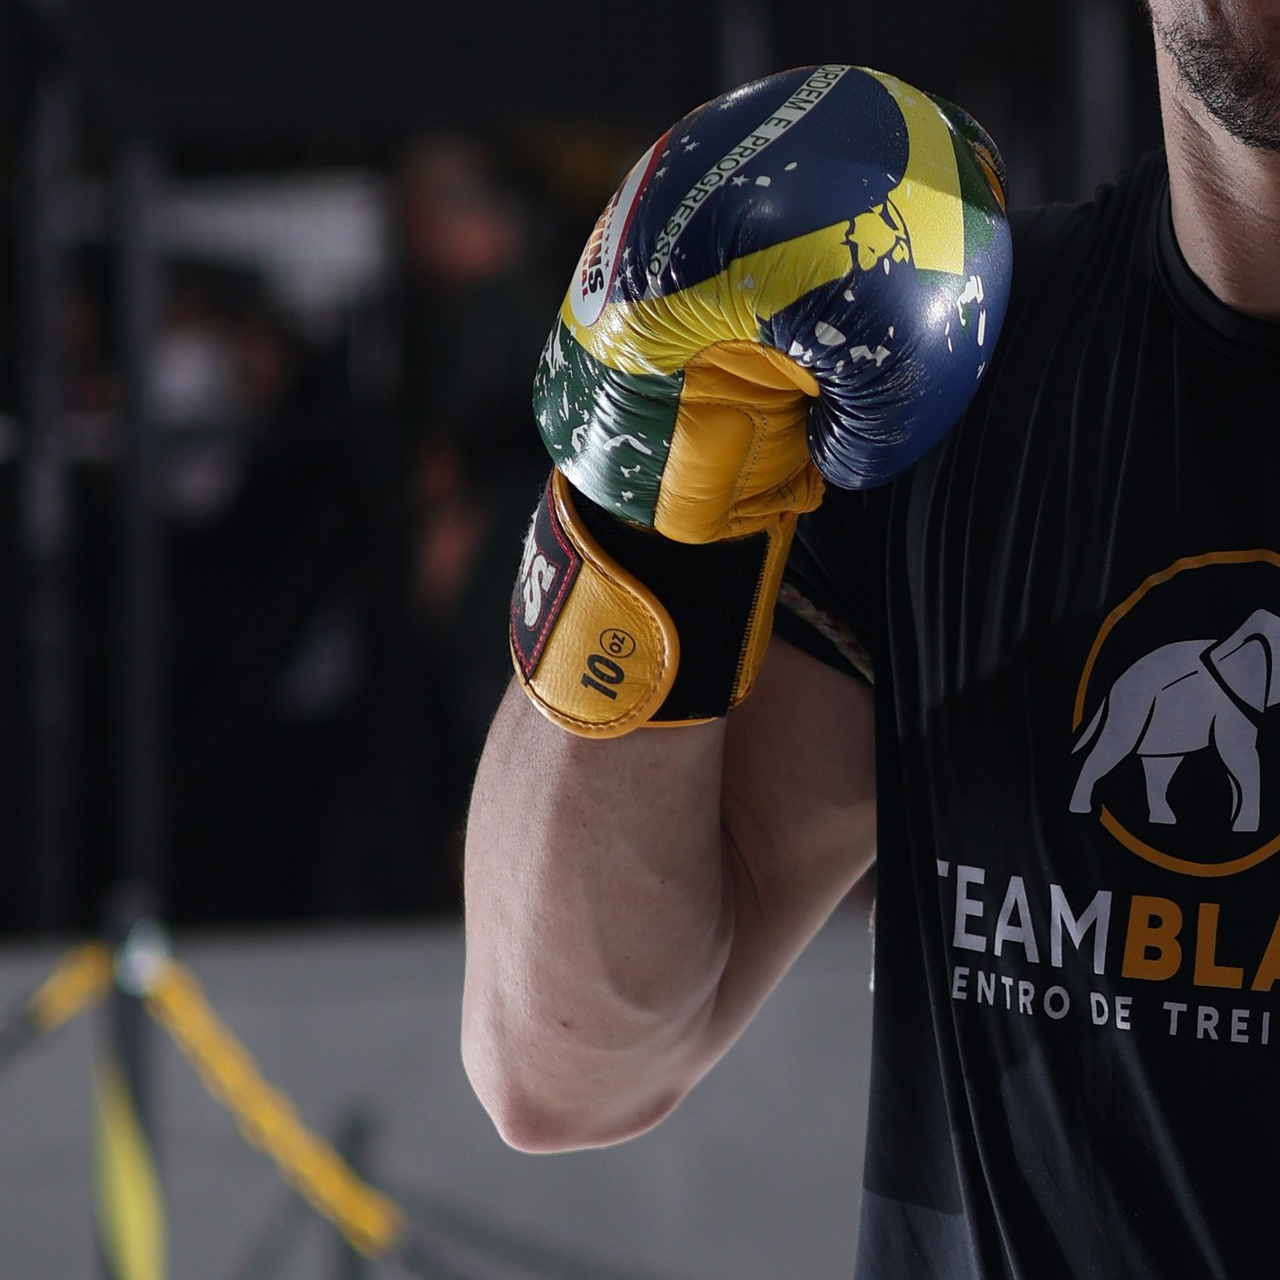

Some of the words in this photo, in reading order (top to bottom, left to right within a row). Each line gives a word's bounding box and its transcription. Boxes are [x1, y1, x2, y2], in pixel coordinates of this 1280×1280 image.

[784, 65, 845, 112] ORDEM
[764, 116, 793, 129] E
[649, 134, 771, 277] PROGRESSO
[580, 653, 625, 700] 10
[951, 966, 1071, 1020] ENTRO
[1089, 991, 1133, 1031] DE
